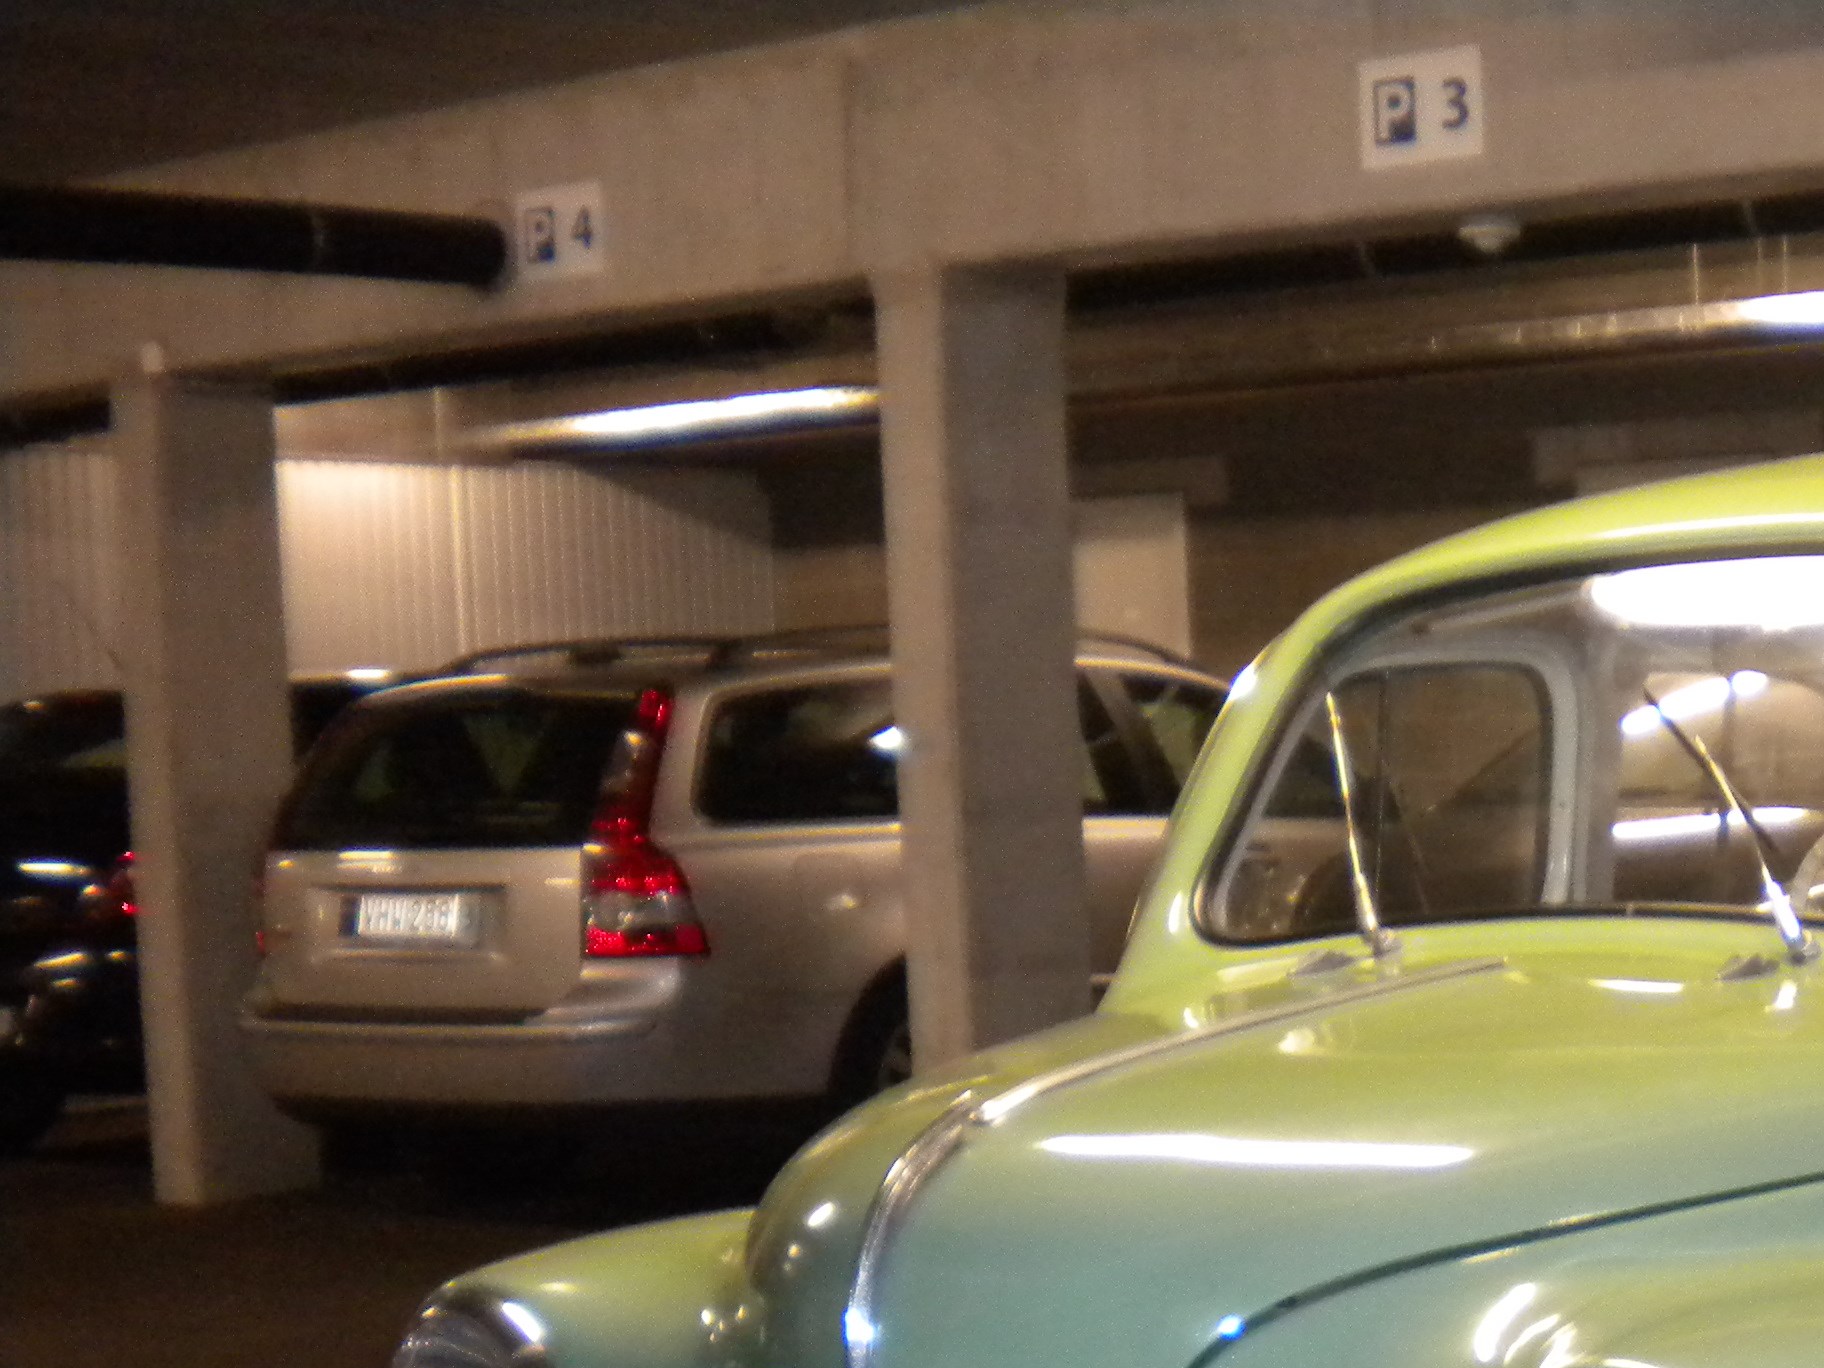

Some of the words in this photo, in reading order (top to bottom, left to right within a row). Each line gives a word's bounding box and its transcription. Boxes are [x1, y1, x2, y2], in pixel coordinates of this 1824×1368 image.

[1375, 80, 1413, 144] P
[1442, 75, 1469, 130] 3
[526, 210, 554, 262] P
[571, 205, 593, 250] 4
